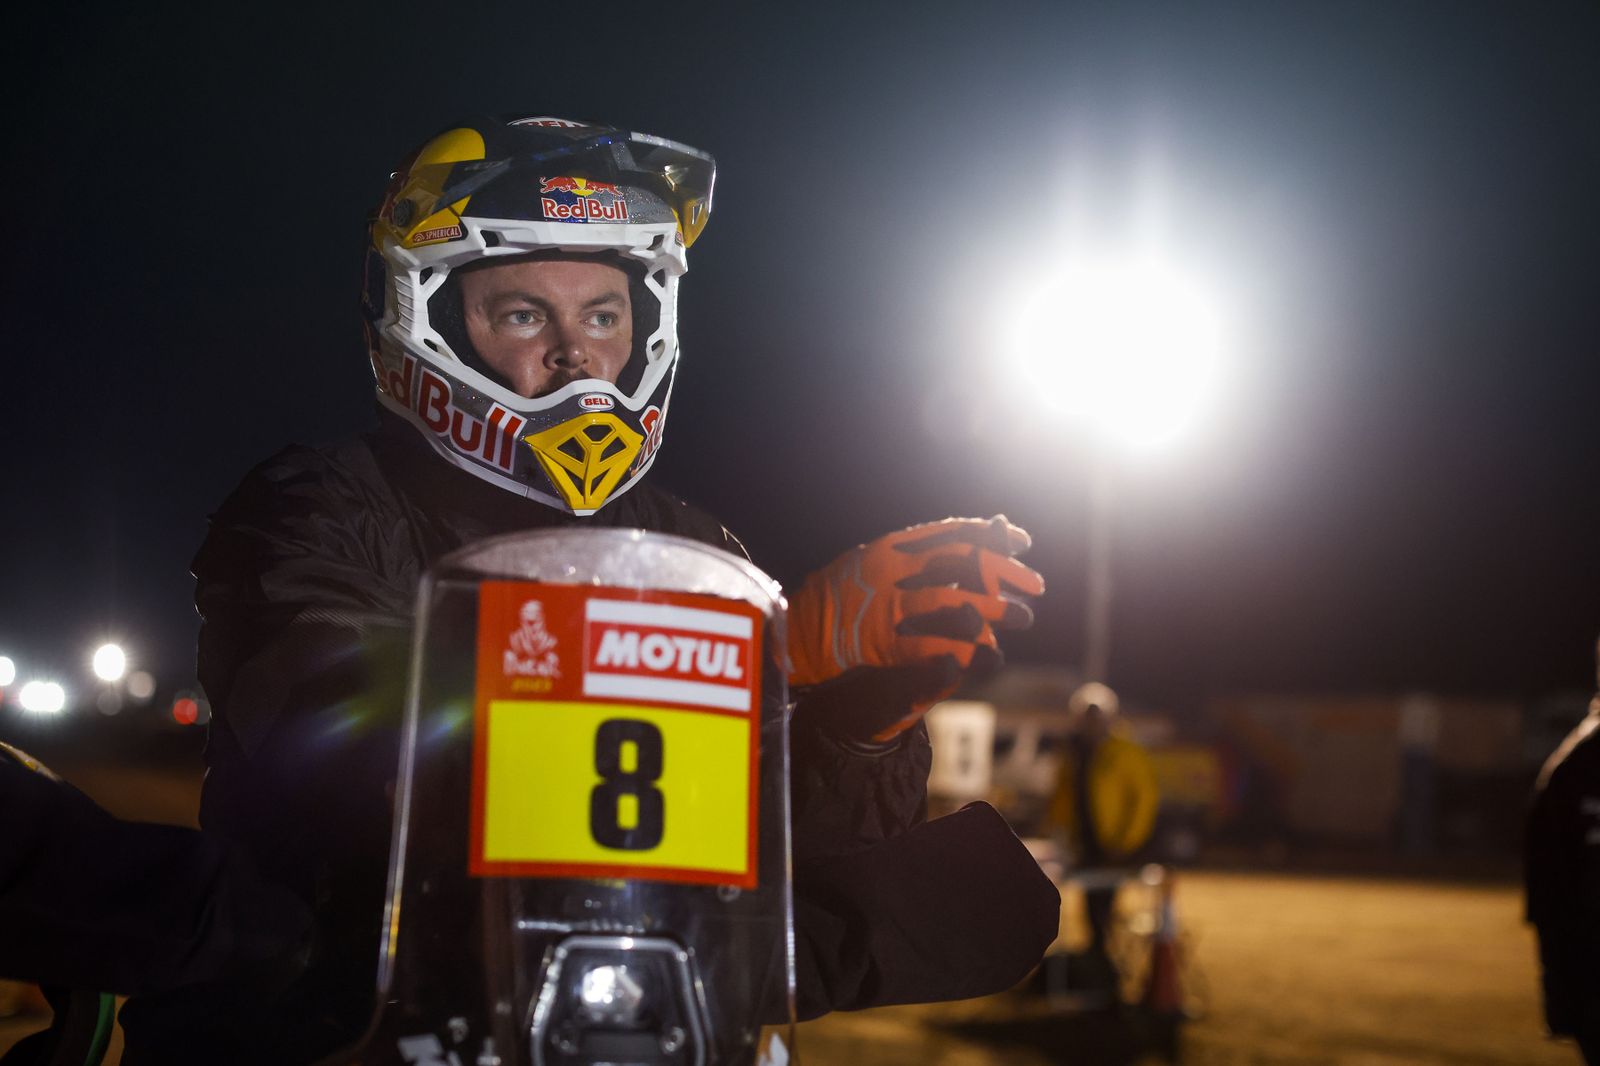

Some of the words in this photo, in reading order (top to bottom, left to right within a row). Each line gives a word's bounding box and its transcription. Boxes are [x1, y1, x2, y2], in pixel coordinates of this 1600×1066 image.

[542, 197, 586, 218] Red
[587, 198, 629, 220] Bull
[425, 227, 459, 240] SPHERICAL
[417, 366, 524, 473] Bull
[584, 397, 611, 406] BELL
[596, 630, 743, 679] MOTUL
[589, 719, 665, 852] 8
